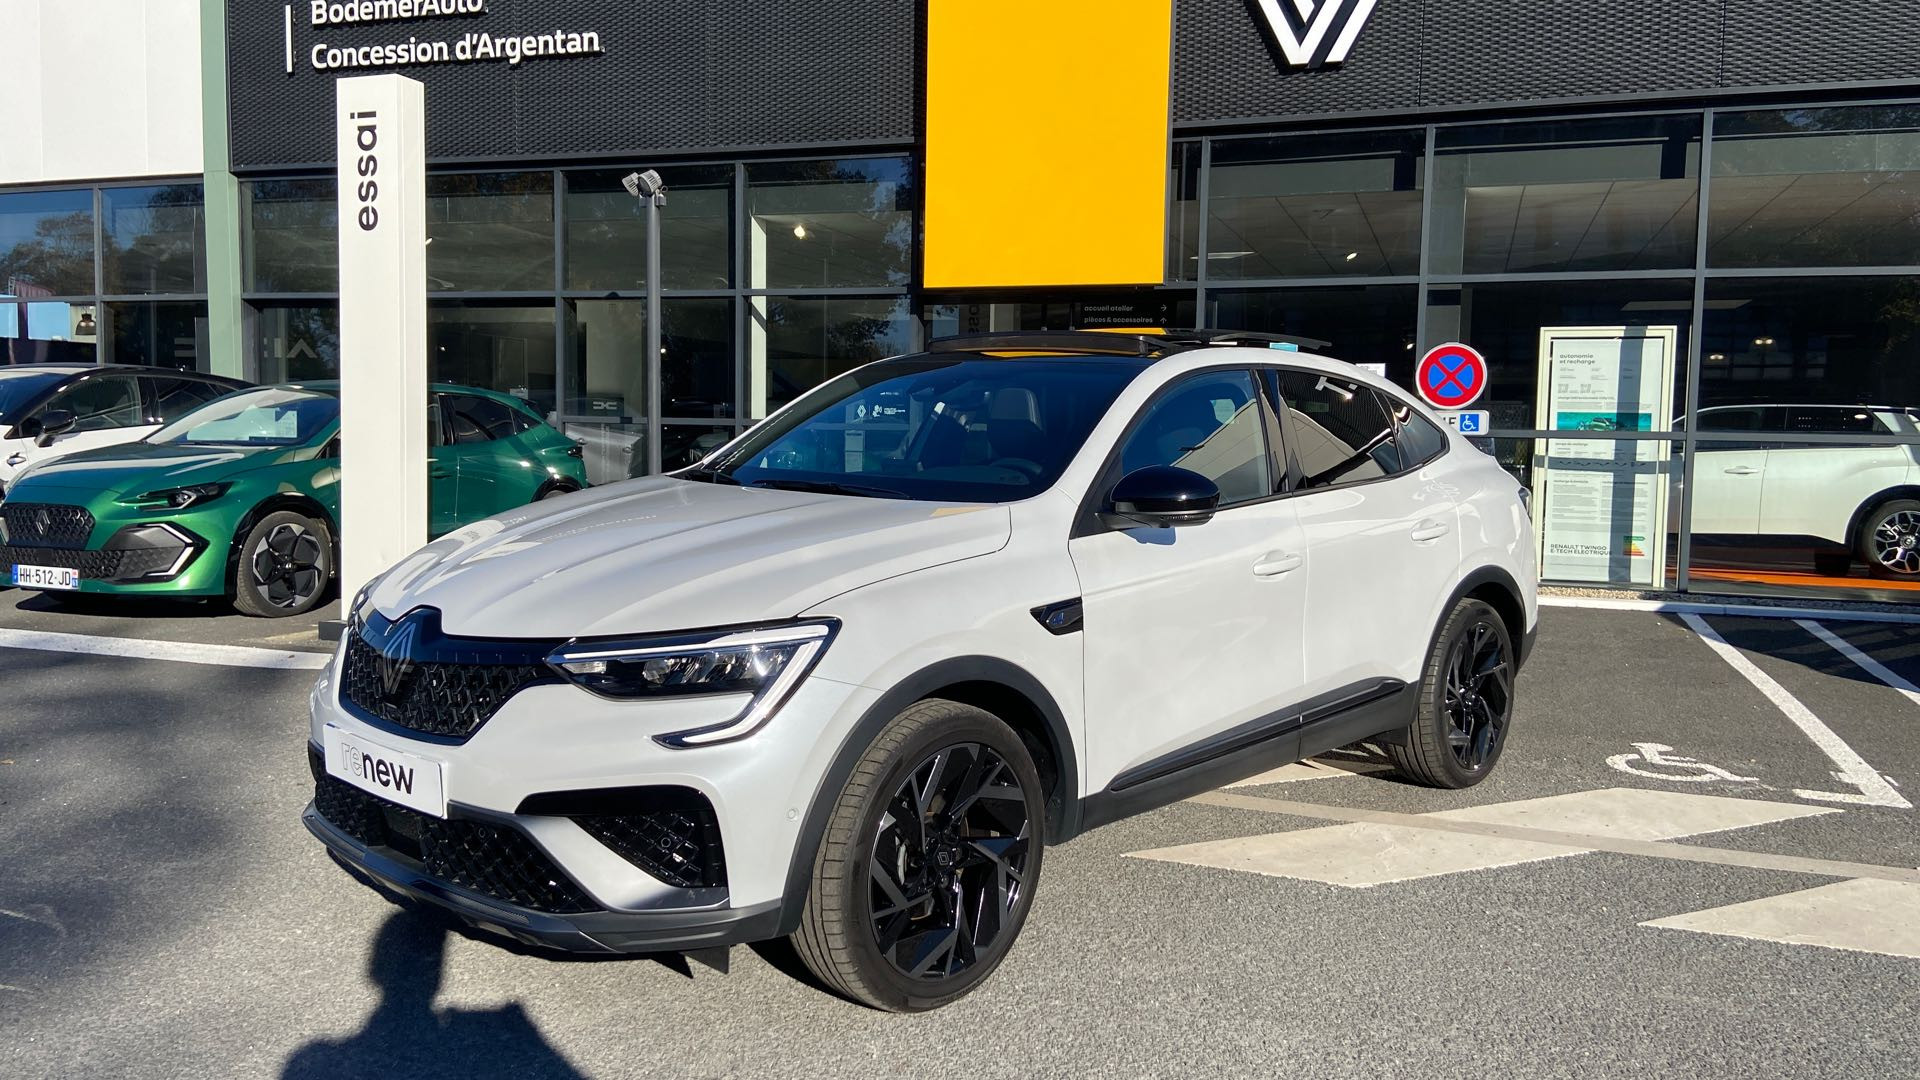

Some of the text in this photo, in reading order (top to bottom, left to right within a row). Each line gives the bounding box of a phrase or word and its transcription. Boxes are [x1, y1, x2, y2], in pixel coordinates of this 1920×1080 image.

[311, 0, 482, 25] BodemerAuto
[311, 29, 600, 69] Concession d'Argentan
[349, 110, 379, 232] essai
[1084, 304, 1133, 312] accueil atelier
[341, 741, 414, 795] renew
